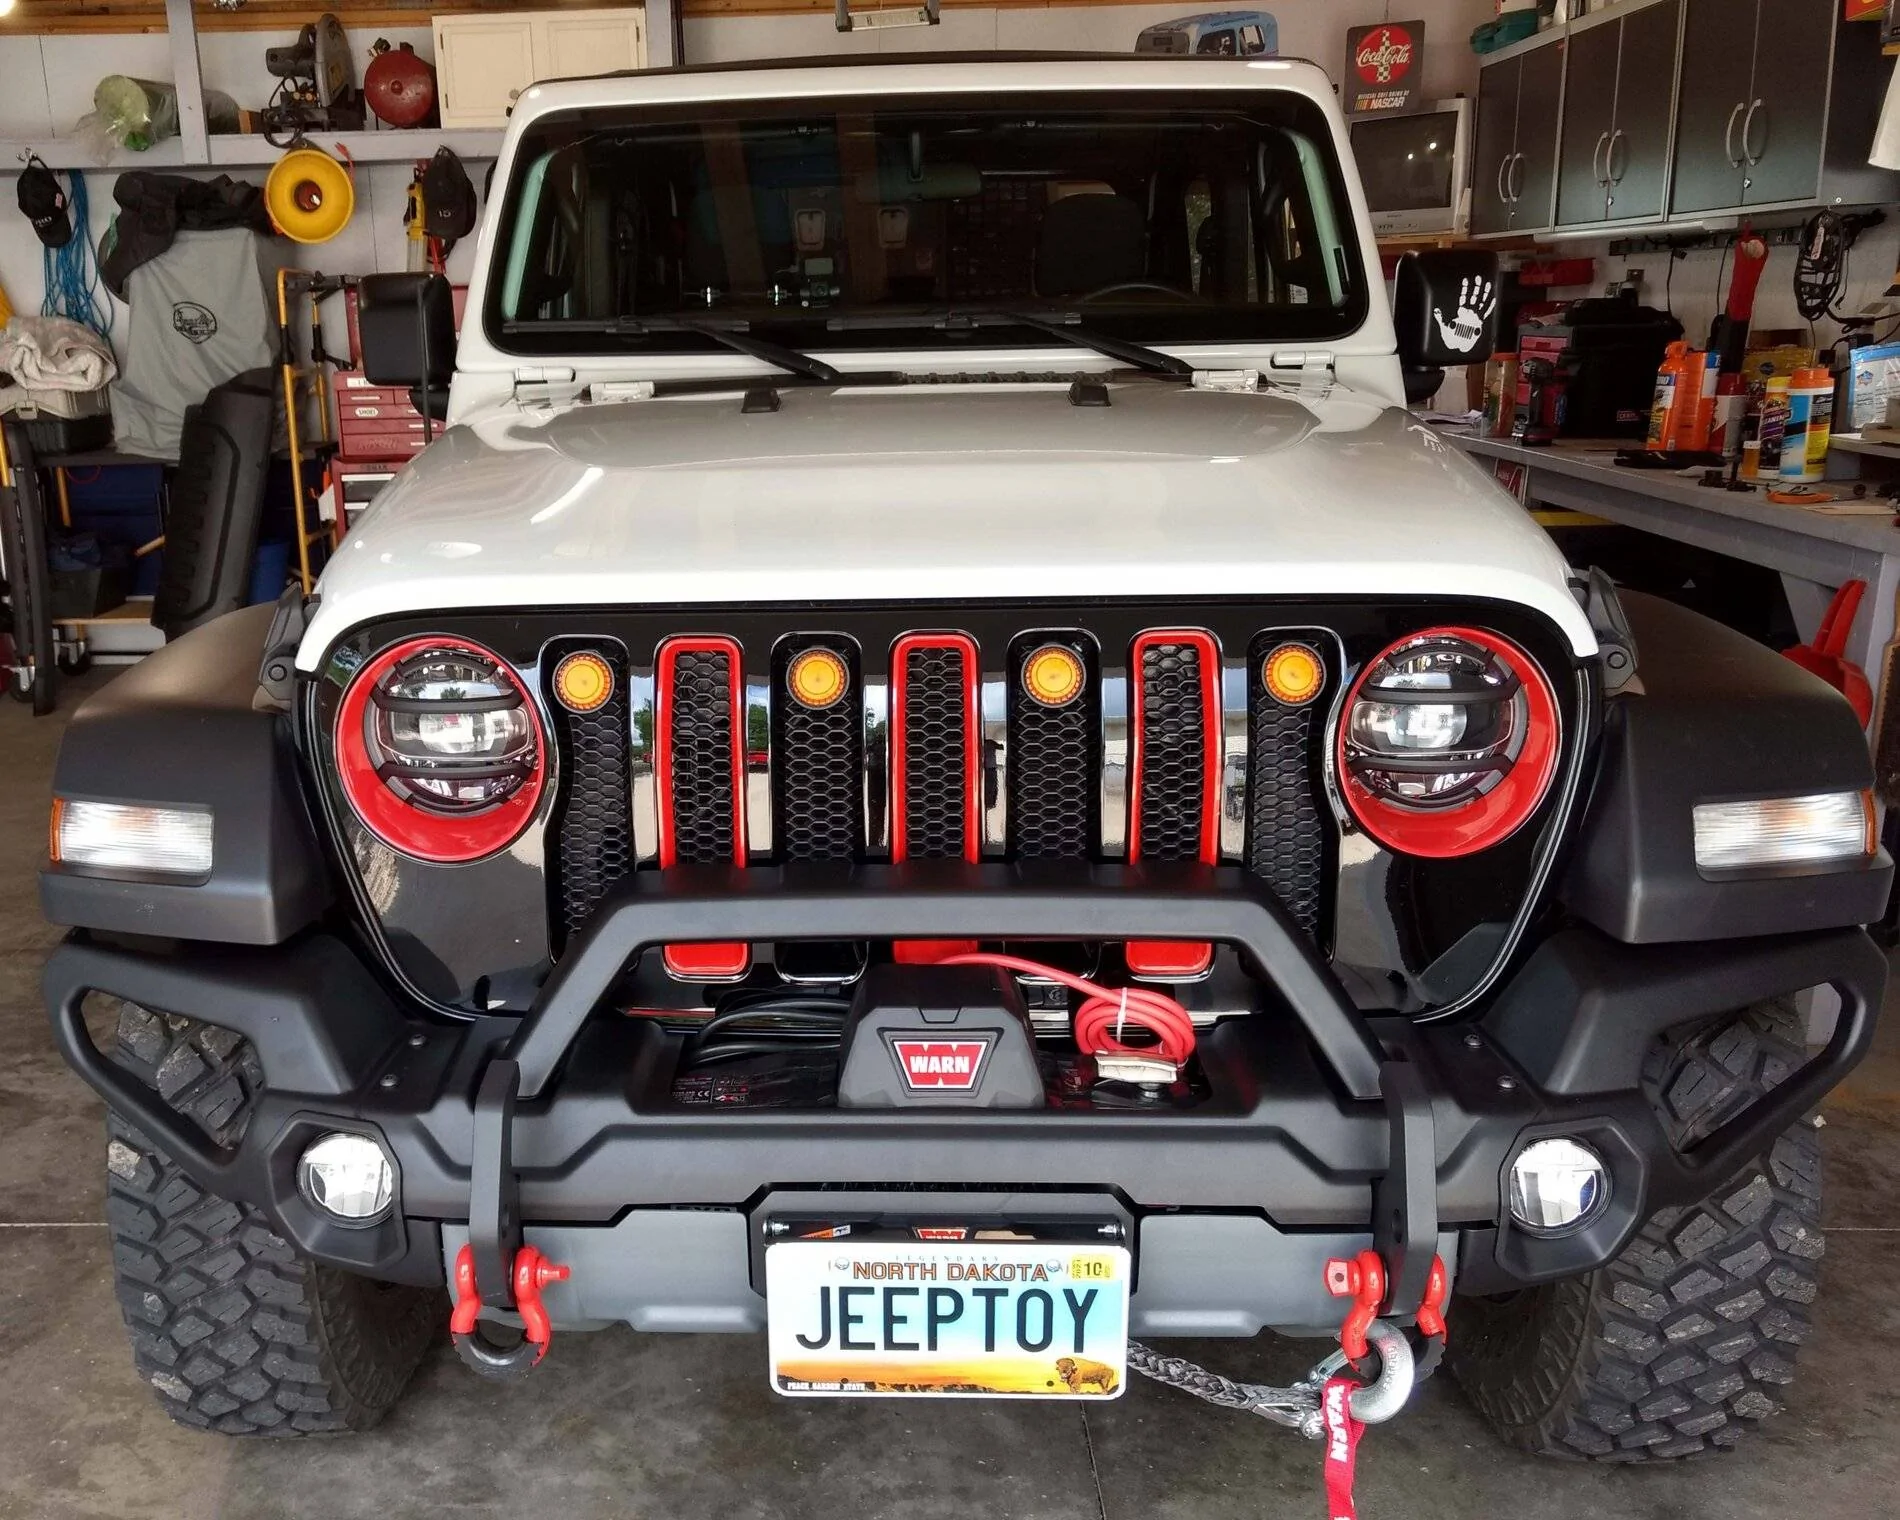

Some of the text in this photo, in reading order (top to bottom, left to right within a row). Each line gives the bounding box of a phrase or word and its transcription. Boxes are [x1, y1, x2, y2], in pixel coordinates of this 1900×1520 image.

[1370, 96, 1405, 109] NASCAR
[909, 1055, 970, 1074] WARN
[853, 1261, 1049, 1281] NORTH DAKOTA
[795, 1286, 1099, 1353] JEEPTOY
[1326, 1384, 1349, 1463] WARN
